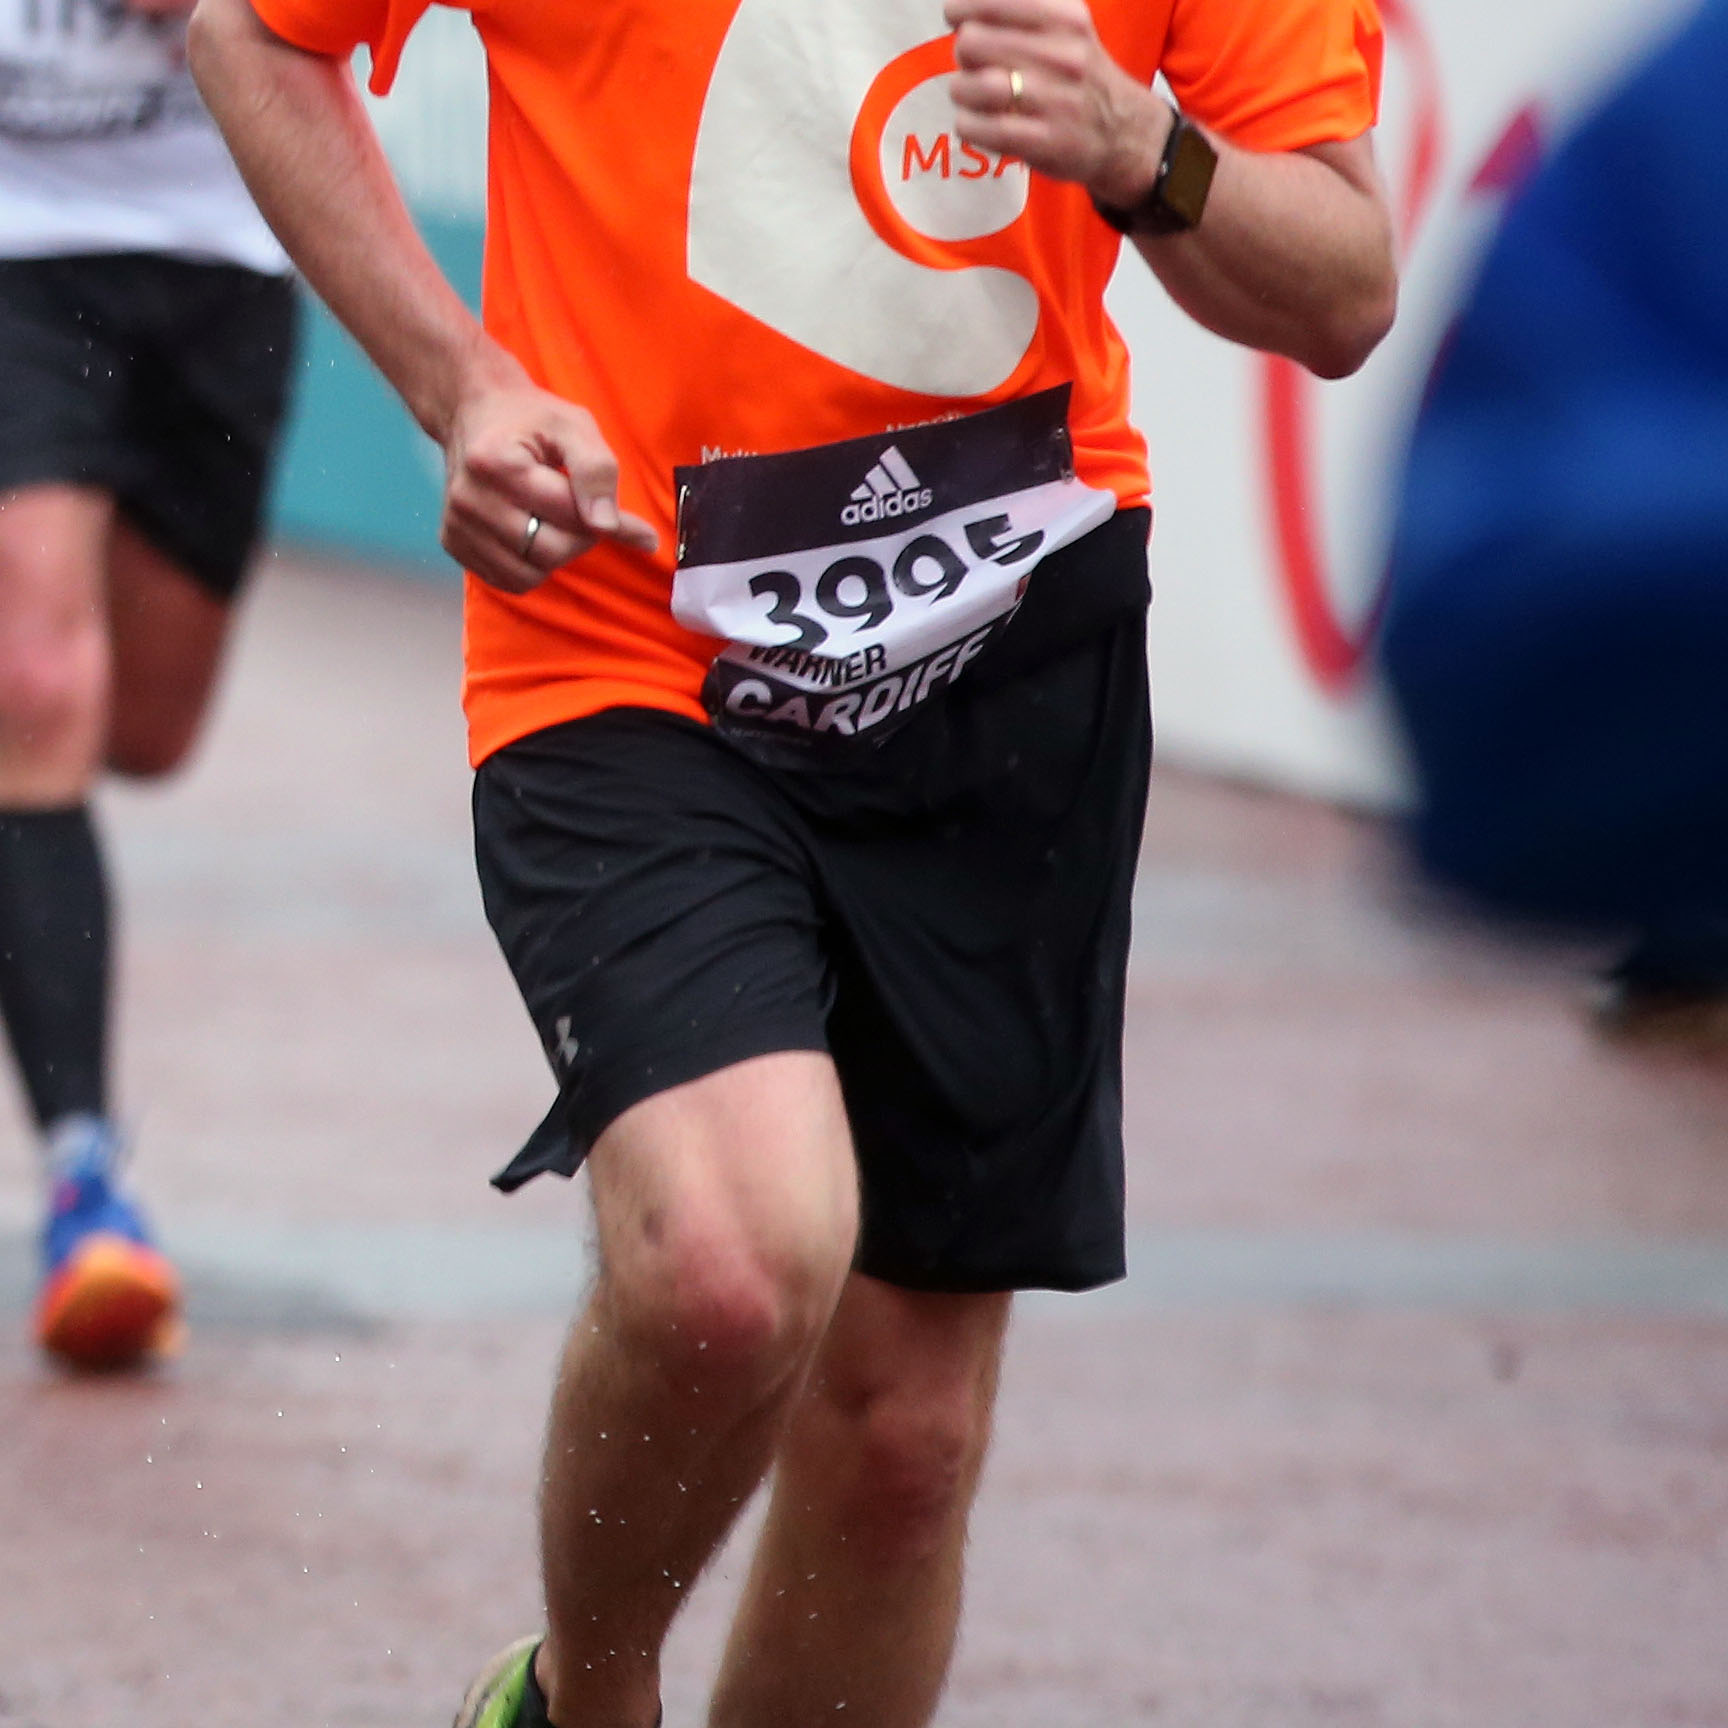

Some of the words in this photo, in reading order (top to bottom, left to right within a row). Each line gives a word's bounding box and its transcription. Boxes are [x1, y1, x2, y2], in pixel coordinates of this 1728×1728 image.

[840, 488, 934, 526] adidas
[748, 513, 1046, 654] 3995
[724, 625, 987, 738] CARDIFF
